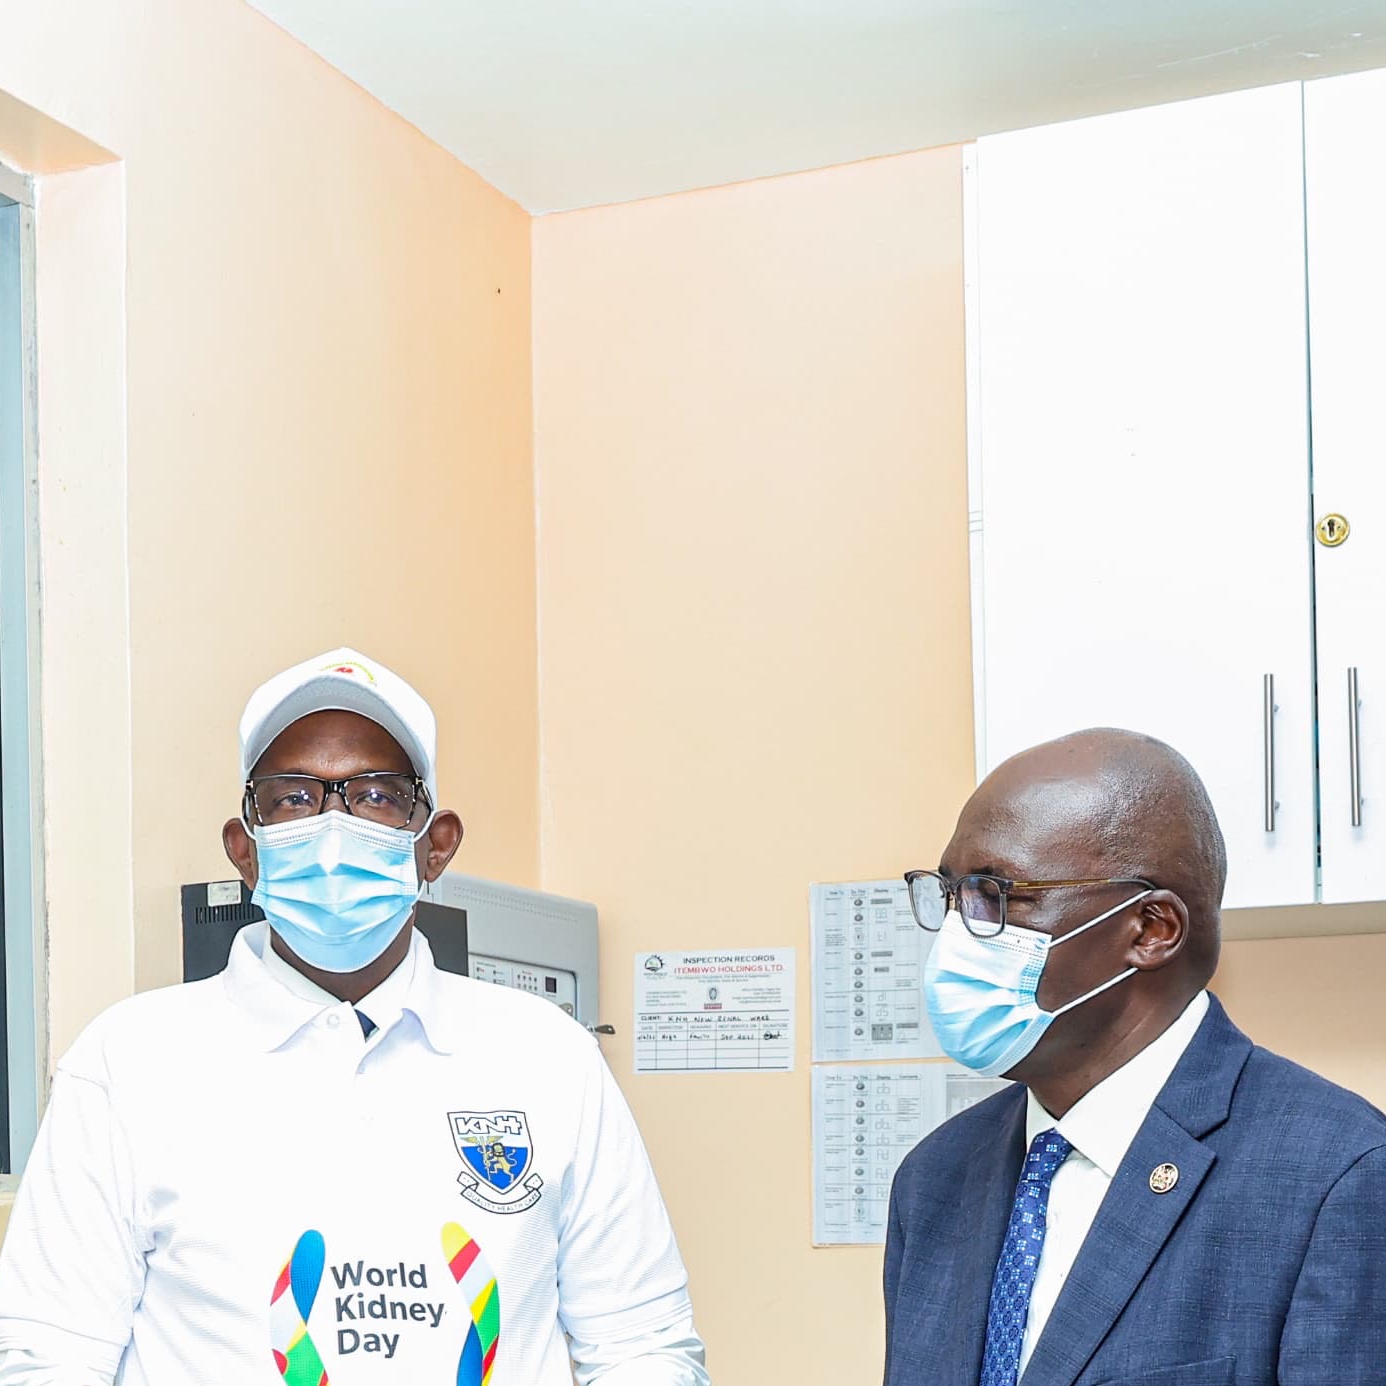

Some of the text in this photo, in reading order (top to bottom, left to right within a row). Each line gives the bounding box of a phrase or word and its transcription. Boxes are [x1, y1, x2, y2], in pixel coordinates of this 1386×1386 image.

[673, 965, 717, 975] ITEMBWO
[717, 963, 764, 973] HOLDINGS
[734, 954, 776, 963] RECORDS
[455, 1115, 523, 1136] KNH
[331, 1260, 428, 1290] World
[335, 1293, 445, 1328] Kidney
[337, 1328, 400, 1359] Day
